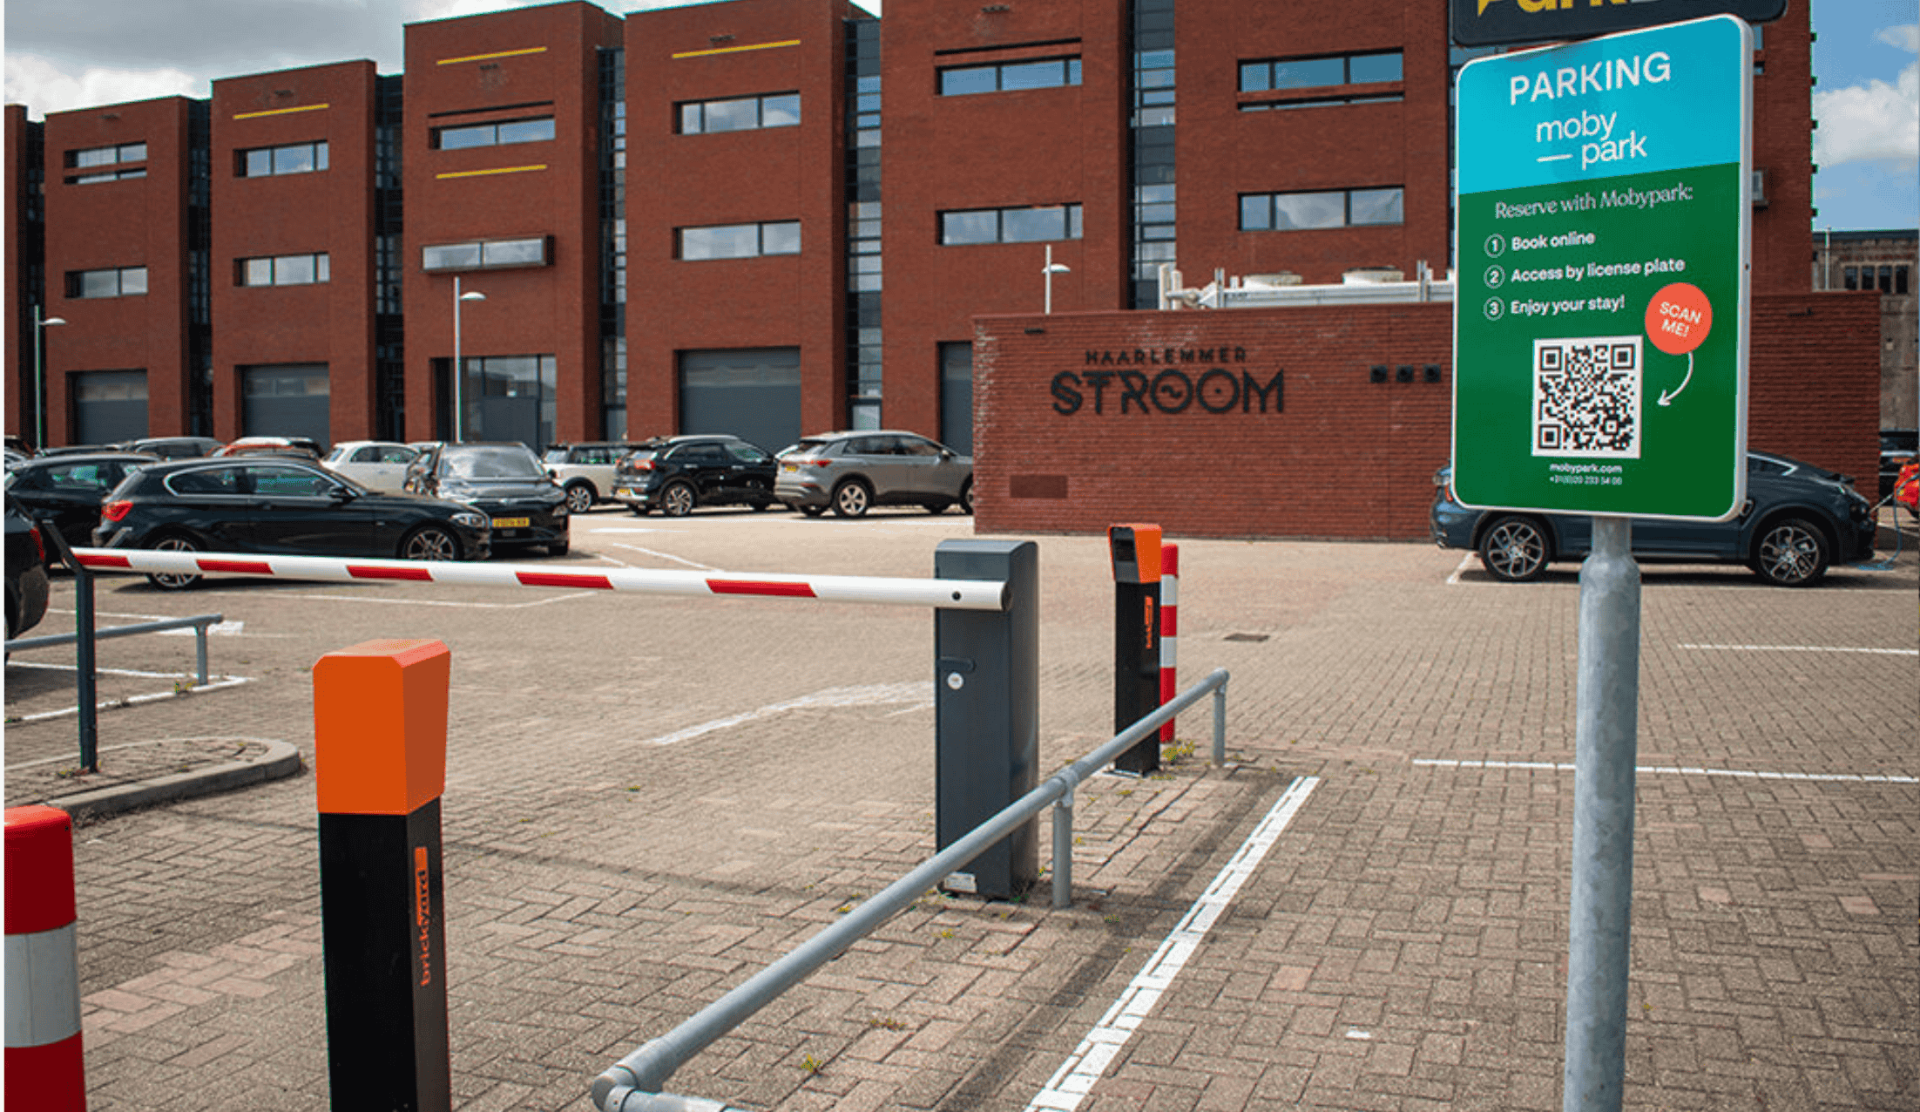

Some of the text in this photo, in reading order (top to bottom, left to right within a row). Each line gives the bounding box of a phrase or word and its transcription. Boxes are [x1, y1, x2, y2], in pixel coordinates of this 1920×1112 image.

[1510, 51, 1671, 106] PARKING
[1536, 110, 1617, 143] moby
[1581, 130, 1648, 171] park
[1495, 182, 1694, 219] Reserve with Mobypark:
[1511, 234, 1548, 251] Book
[1550, 231, 1596, 248] online
[1511, 268, 1564, 283] Access
[1566, 264, 1584, 281] by
[1587, 261, 1642, 277] license
[1644, 258, 1686, 277] plate
[1511, 299, 1550, 316] Enjoy
[1552, 299, 1585, 316] your
[1588, 294, 1625, 313] stay!
[1659, 301, 1701, 325] SCAN
[1661, 318, 1690, 338] ME!
[1086, 347, 1247, 365] HAARLEMMER
[1051, 368, 1284, 416] STROOM
[1549, 463, 1623, 475] mobypark.com
[417, 869, 431, 986] brickyard
